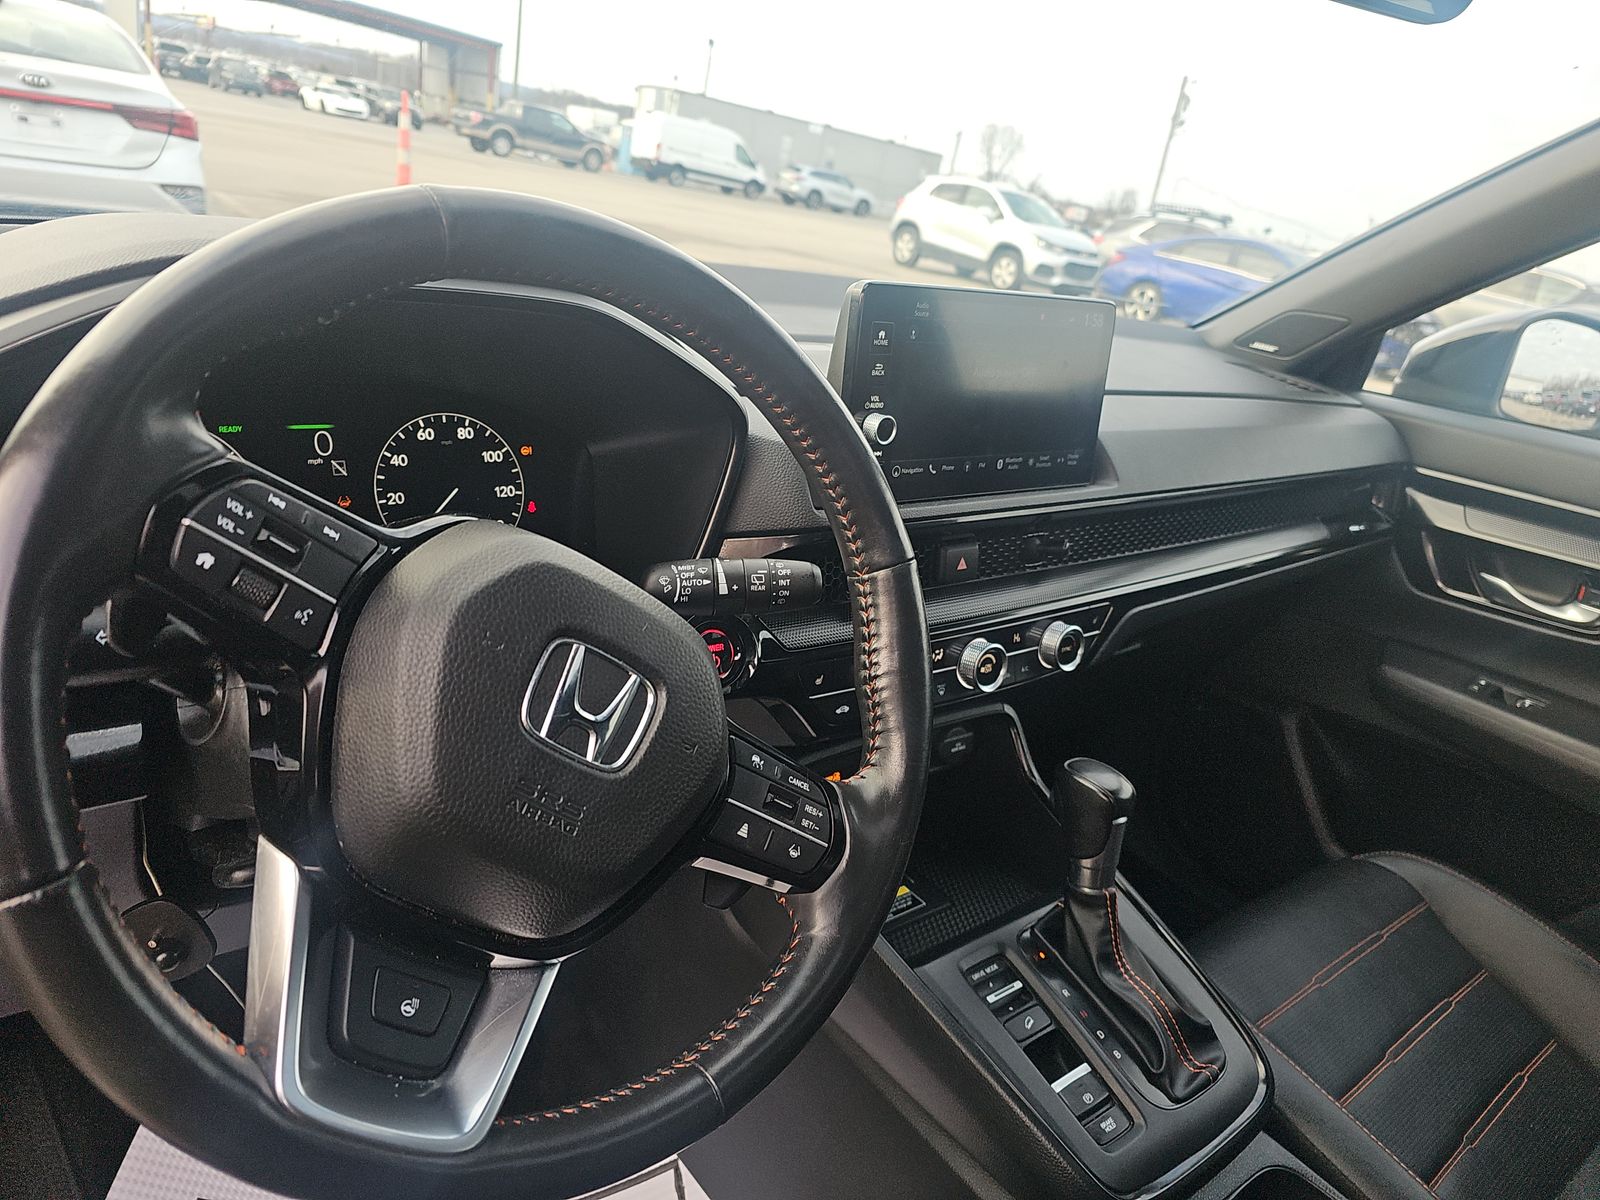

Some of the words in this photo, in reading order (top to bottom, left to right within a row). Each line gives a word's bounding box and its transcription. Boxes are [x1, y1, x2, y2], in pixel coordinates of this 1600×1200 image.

[916, 301, 930, 309] Audio
[218, 425, 243, 433] READY
[417, 428, 435, 441] 60
[457, 427, 474, 440] 80
[314, 430, 334, 456] 0
[307, 458, 324, 466] mph
[389, 454, 409, 467] 40
[481, 451, 504, 463] 100
[901, 467, 924, 475] Navigation
[494, 486, 516, 498] 120
[387, 493, 405, 505] 20
[681, 587, 692, 595] LO
[788, 775, 811, 792] CANCEL
[1061, 988, 1071, 998] R
[1096, 1029, 1105, 1040] D
[1112, 1049, 1122, 1060] B
